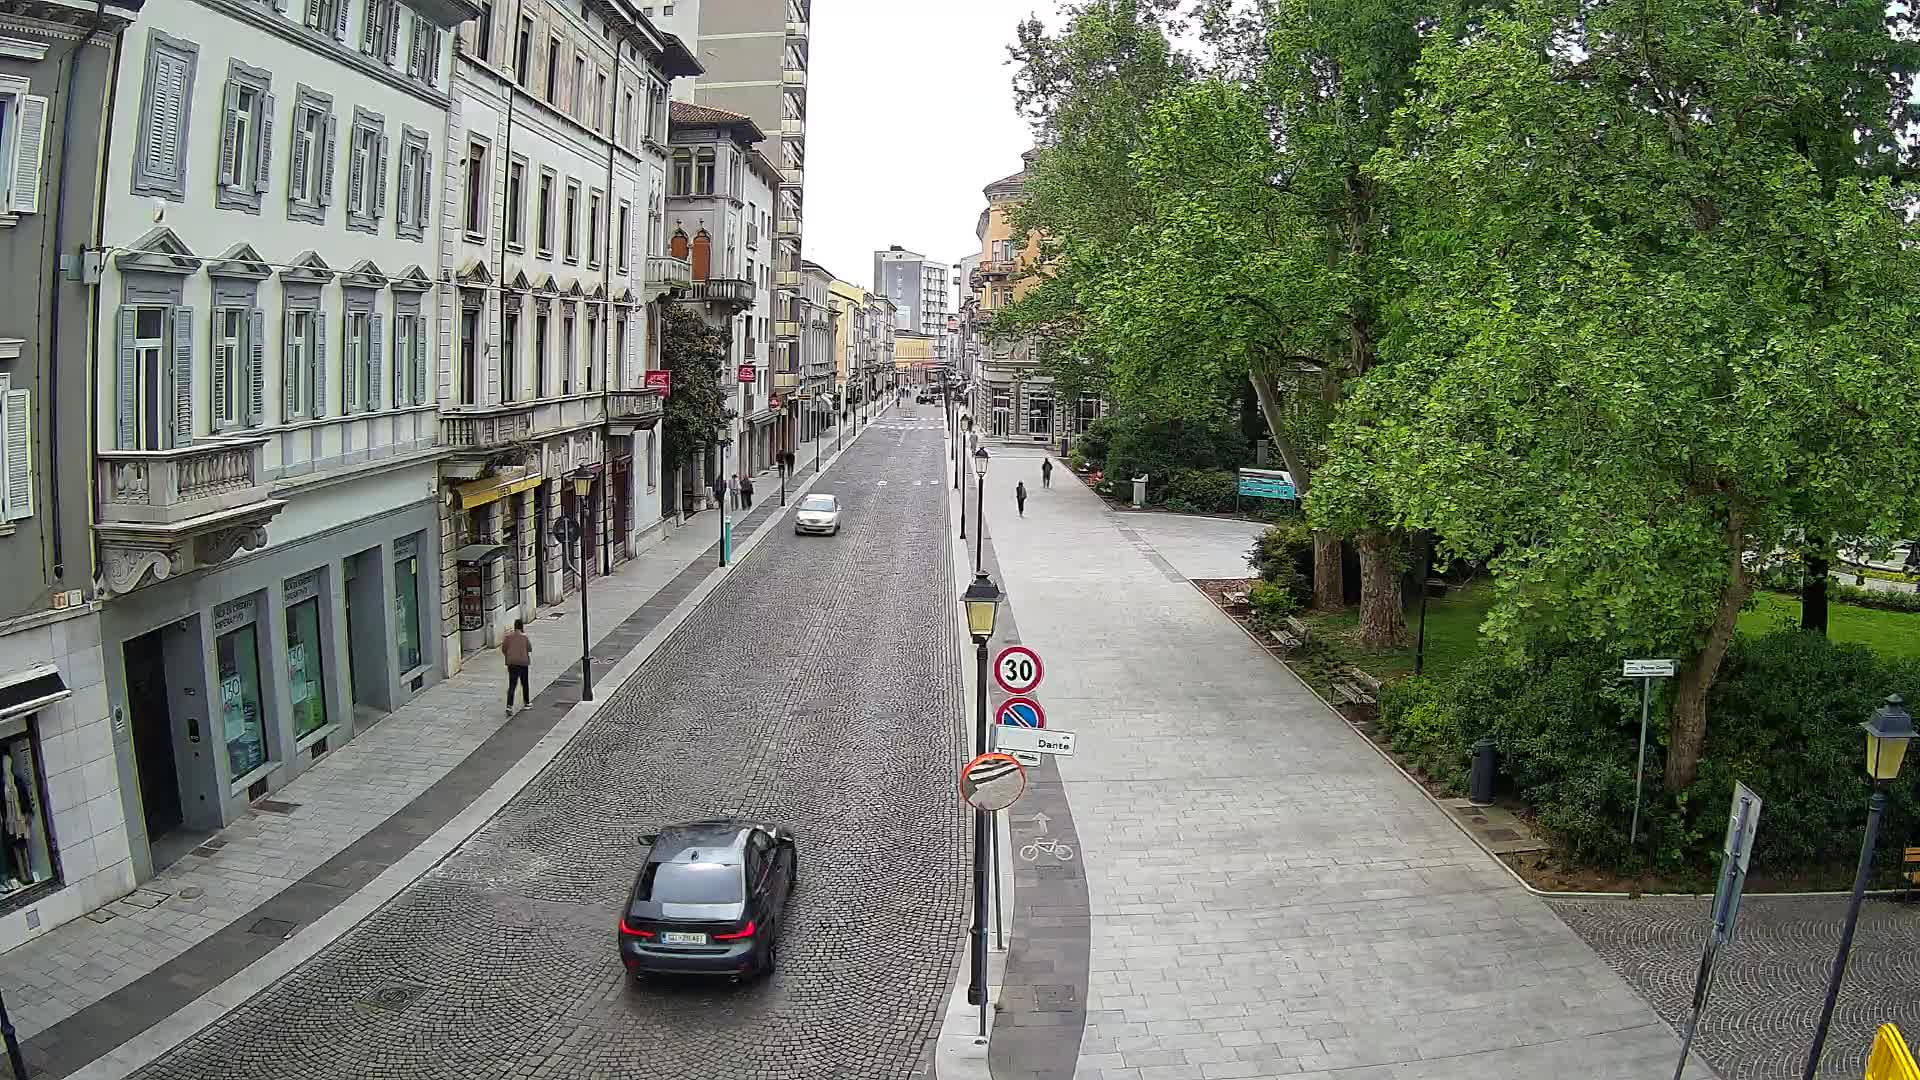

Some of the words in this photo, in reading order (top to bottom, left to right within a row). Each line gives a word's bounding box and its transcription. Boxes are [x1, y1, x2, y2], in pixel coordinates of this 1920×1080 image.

[1005, 659, 1033, 681] 30
[220, 678, 240, 702] 130
[1038, 739, 1070, 750] Dante
